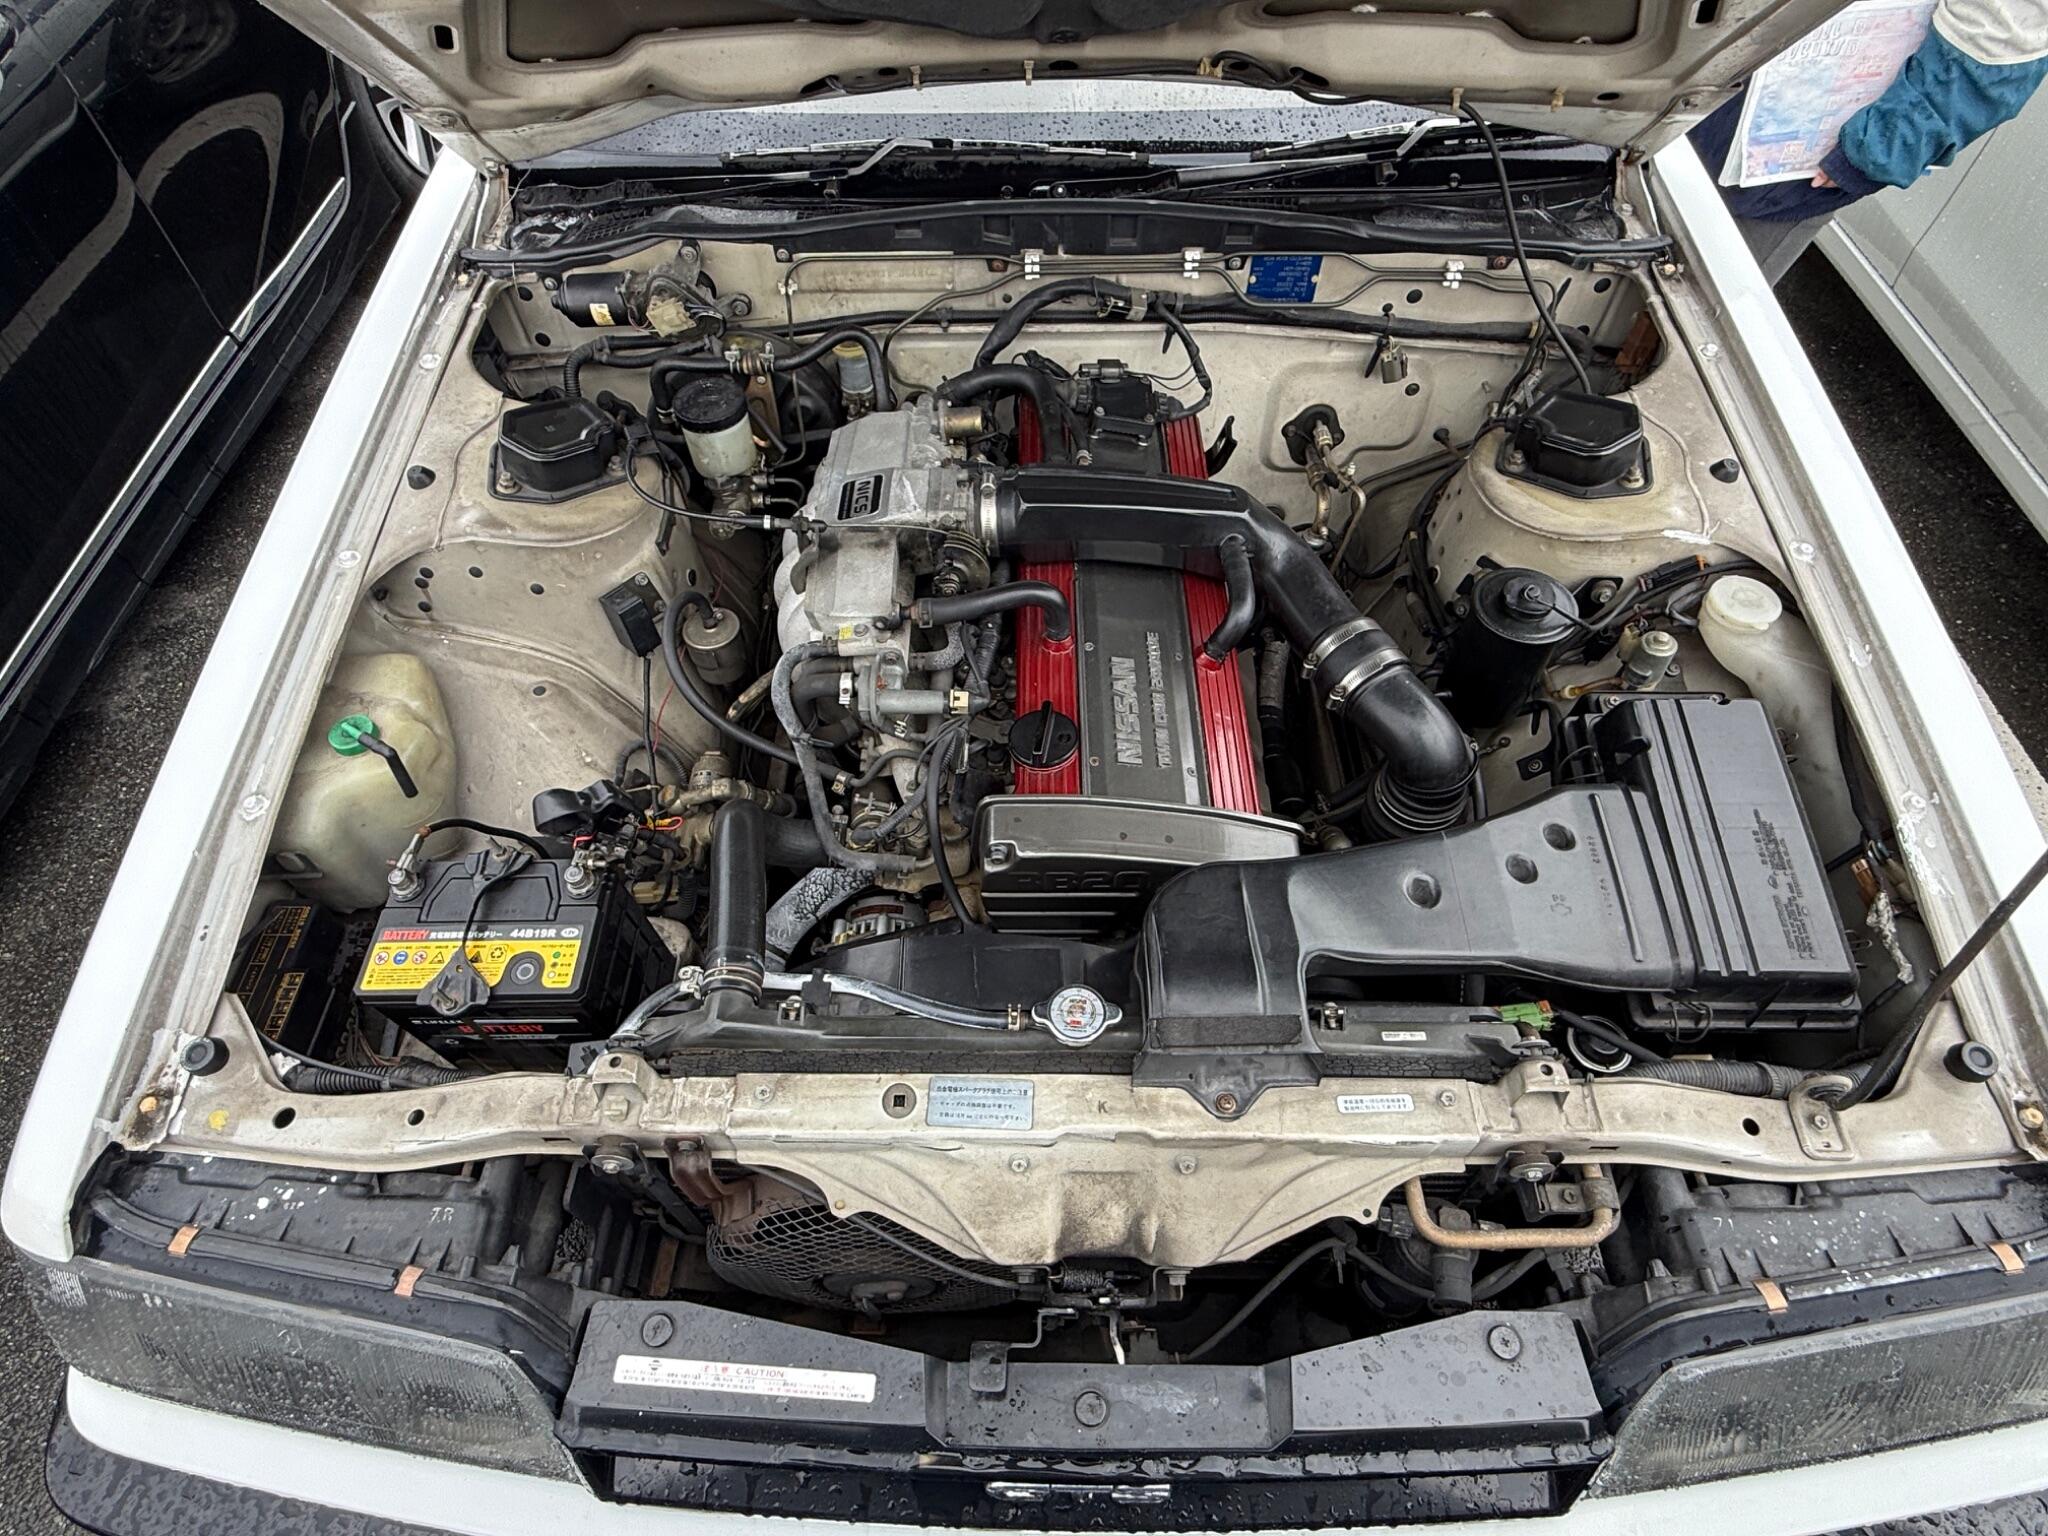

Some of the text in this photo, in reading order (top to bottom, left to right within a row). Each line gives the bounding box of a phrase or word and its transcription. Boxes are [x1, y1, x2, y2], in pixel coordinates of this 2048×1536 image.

[853, 480, 871, 514] NICS
[1110, 656, 1143, 768] NISSAN
[1155, 727, 1172, 768] TWIN
[382, 930, 430, 941] BATTERY
[510, 927, 556, 939] 44B19R
[735, 1366, 786, 1379] CAUTION
